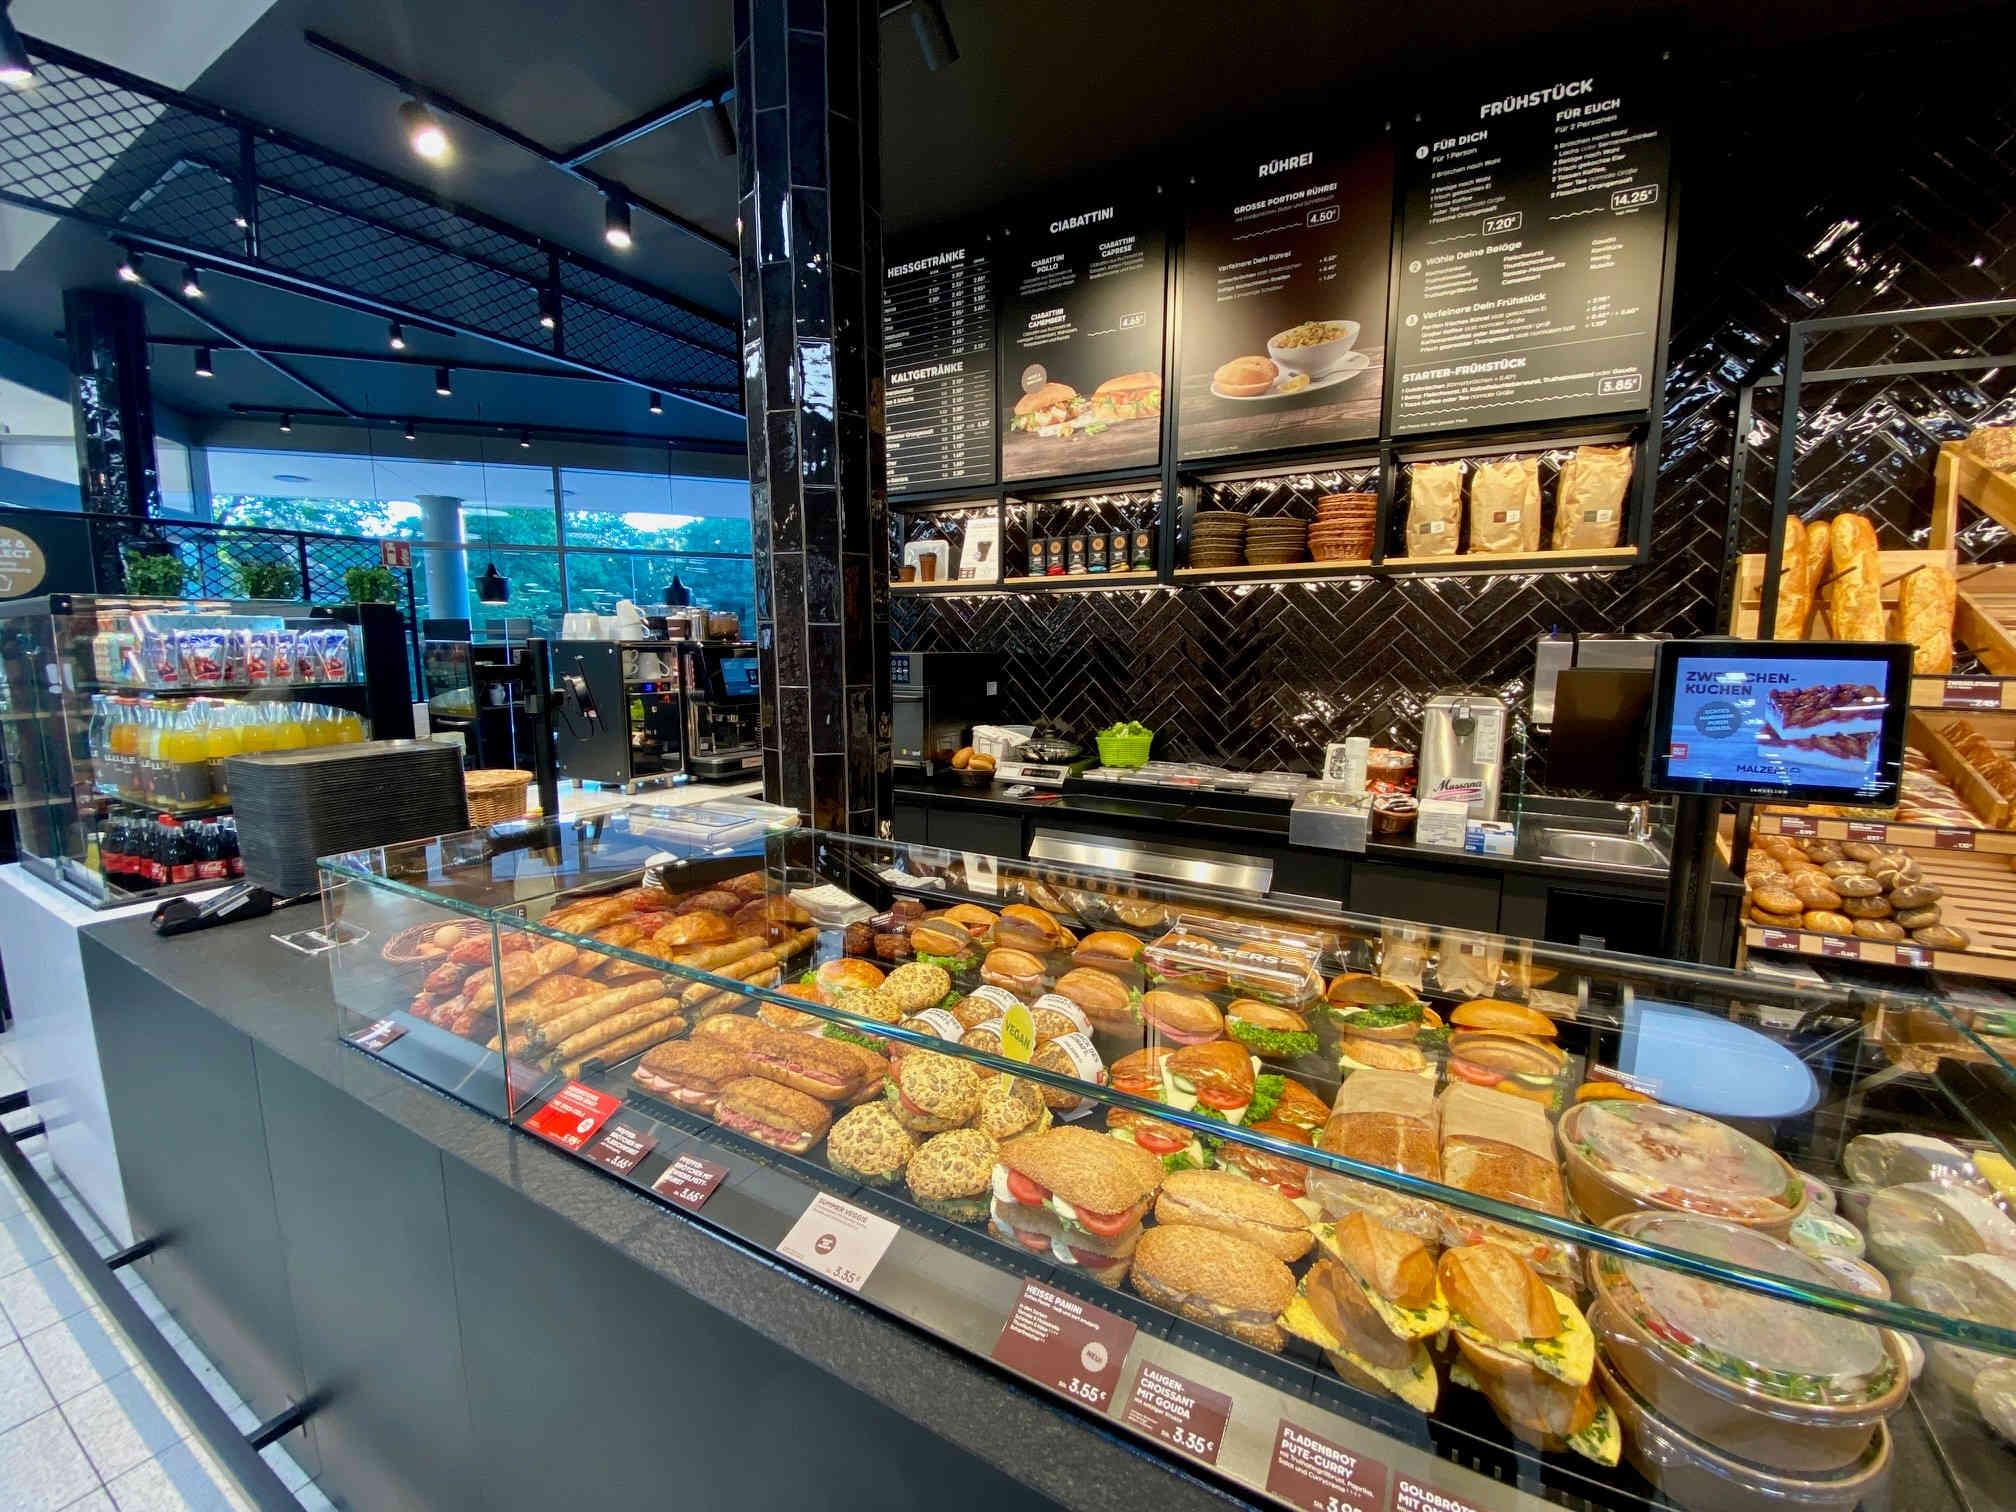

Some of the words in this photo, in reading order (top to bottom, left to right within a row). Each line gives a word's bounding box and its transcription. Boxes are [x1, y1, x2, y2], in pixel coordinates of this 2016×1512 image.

[1480, 78, 1594, 119] FRÜHSTÜCK
[1556, 107, 1581, 122] FÜR
[1584, 98, 1620, 115] EUCH
[1433, 136, 1456, 151] FÜR
[1458, 130, 1488, 145] DICH
[1258, 152, 1313, 178] RÜHREI
[1234, 200, 1266, 215] GROSSE
[1267, 191, 1305, 207] PORTION
[1307, 182, 1338, 197] RÜHREI
[1050, 207, 1114, 234] CIABATTINI
[888, 248, 966, 279] HEISSGETRÄNKE
[891, 361, 964, 384] KALTGETRÄNKE
[1401, 357, 1527, 383] STARTER-FRÜHSTÜCK
[1685, 683, 1752, 695] KUCHEN
[1176, 939, 1280, 965] MALZERS
[1005, 1023, 1031, 1050] VEGAN
[1027, 1284, 1055, 1303] HEISSE
[1054, 1295, 1083, 1315] PANINI
[1141, 1378, 1196, 1408] CROISSANT
[1143, 1367, 1185, 1392] LAUGEN-
[1136, 1387, 1156, 1401] MIT
[1155, 1396, 1191, 1419] GOUDA
[1172, 1426, 1214, 1454] 3.35€
[1283, 1427, 1357, 1468] FLADENBROT
[1281, 1439, 1354, 1478] PUTE-CURRY
[1398, 1493, 1420, 1510] MIT
